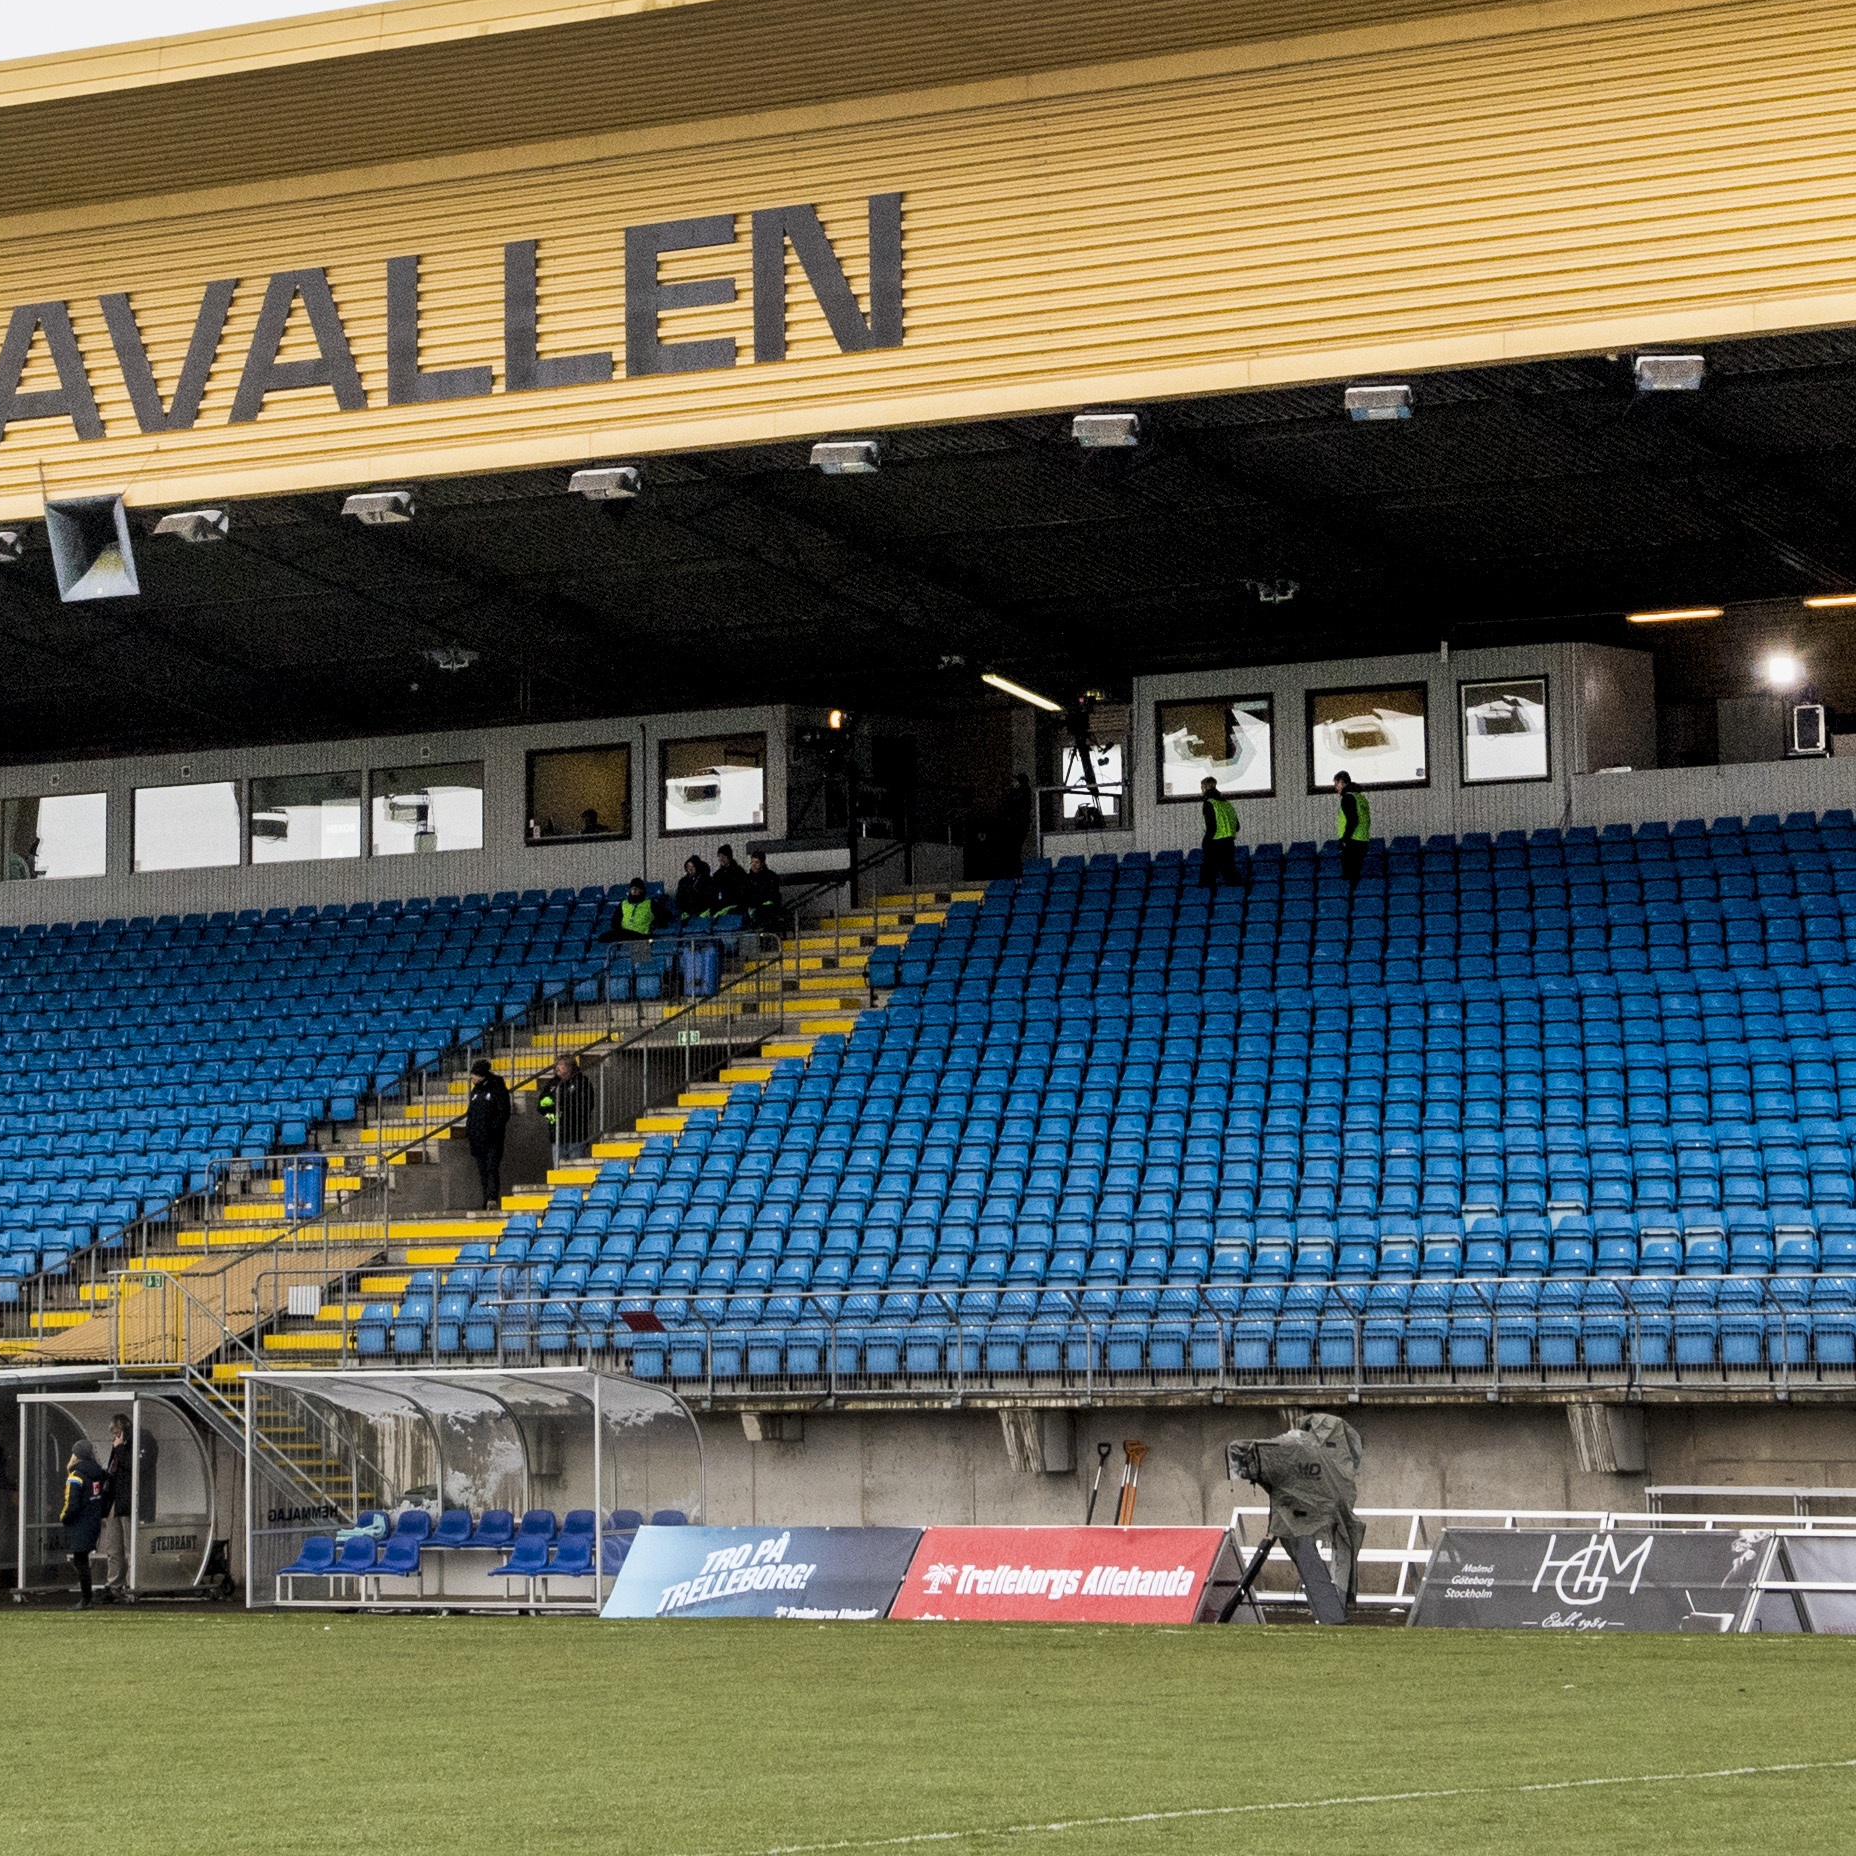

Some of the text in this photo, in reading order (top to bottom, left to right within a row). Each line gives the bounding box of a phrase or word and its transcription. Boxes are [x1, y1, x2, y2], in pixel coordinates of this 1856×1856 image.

[699, 1530, 791, 1576] TRO PÅ
[1461, 1564, 1495, 1573] Malmö
[655, 1563, 817, 1615] TRELLEBORG!
[955, 1564, 1196, 1600] Trelleborgs Allehanda
[1451, 1575, 1494, 1587] Göteborg
[1444, 1588, 1492, 1599] Stockholm
